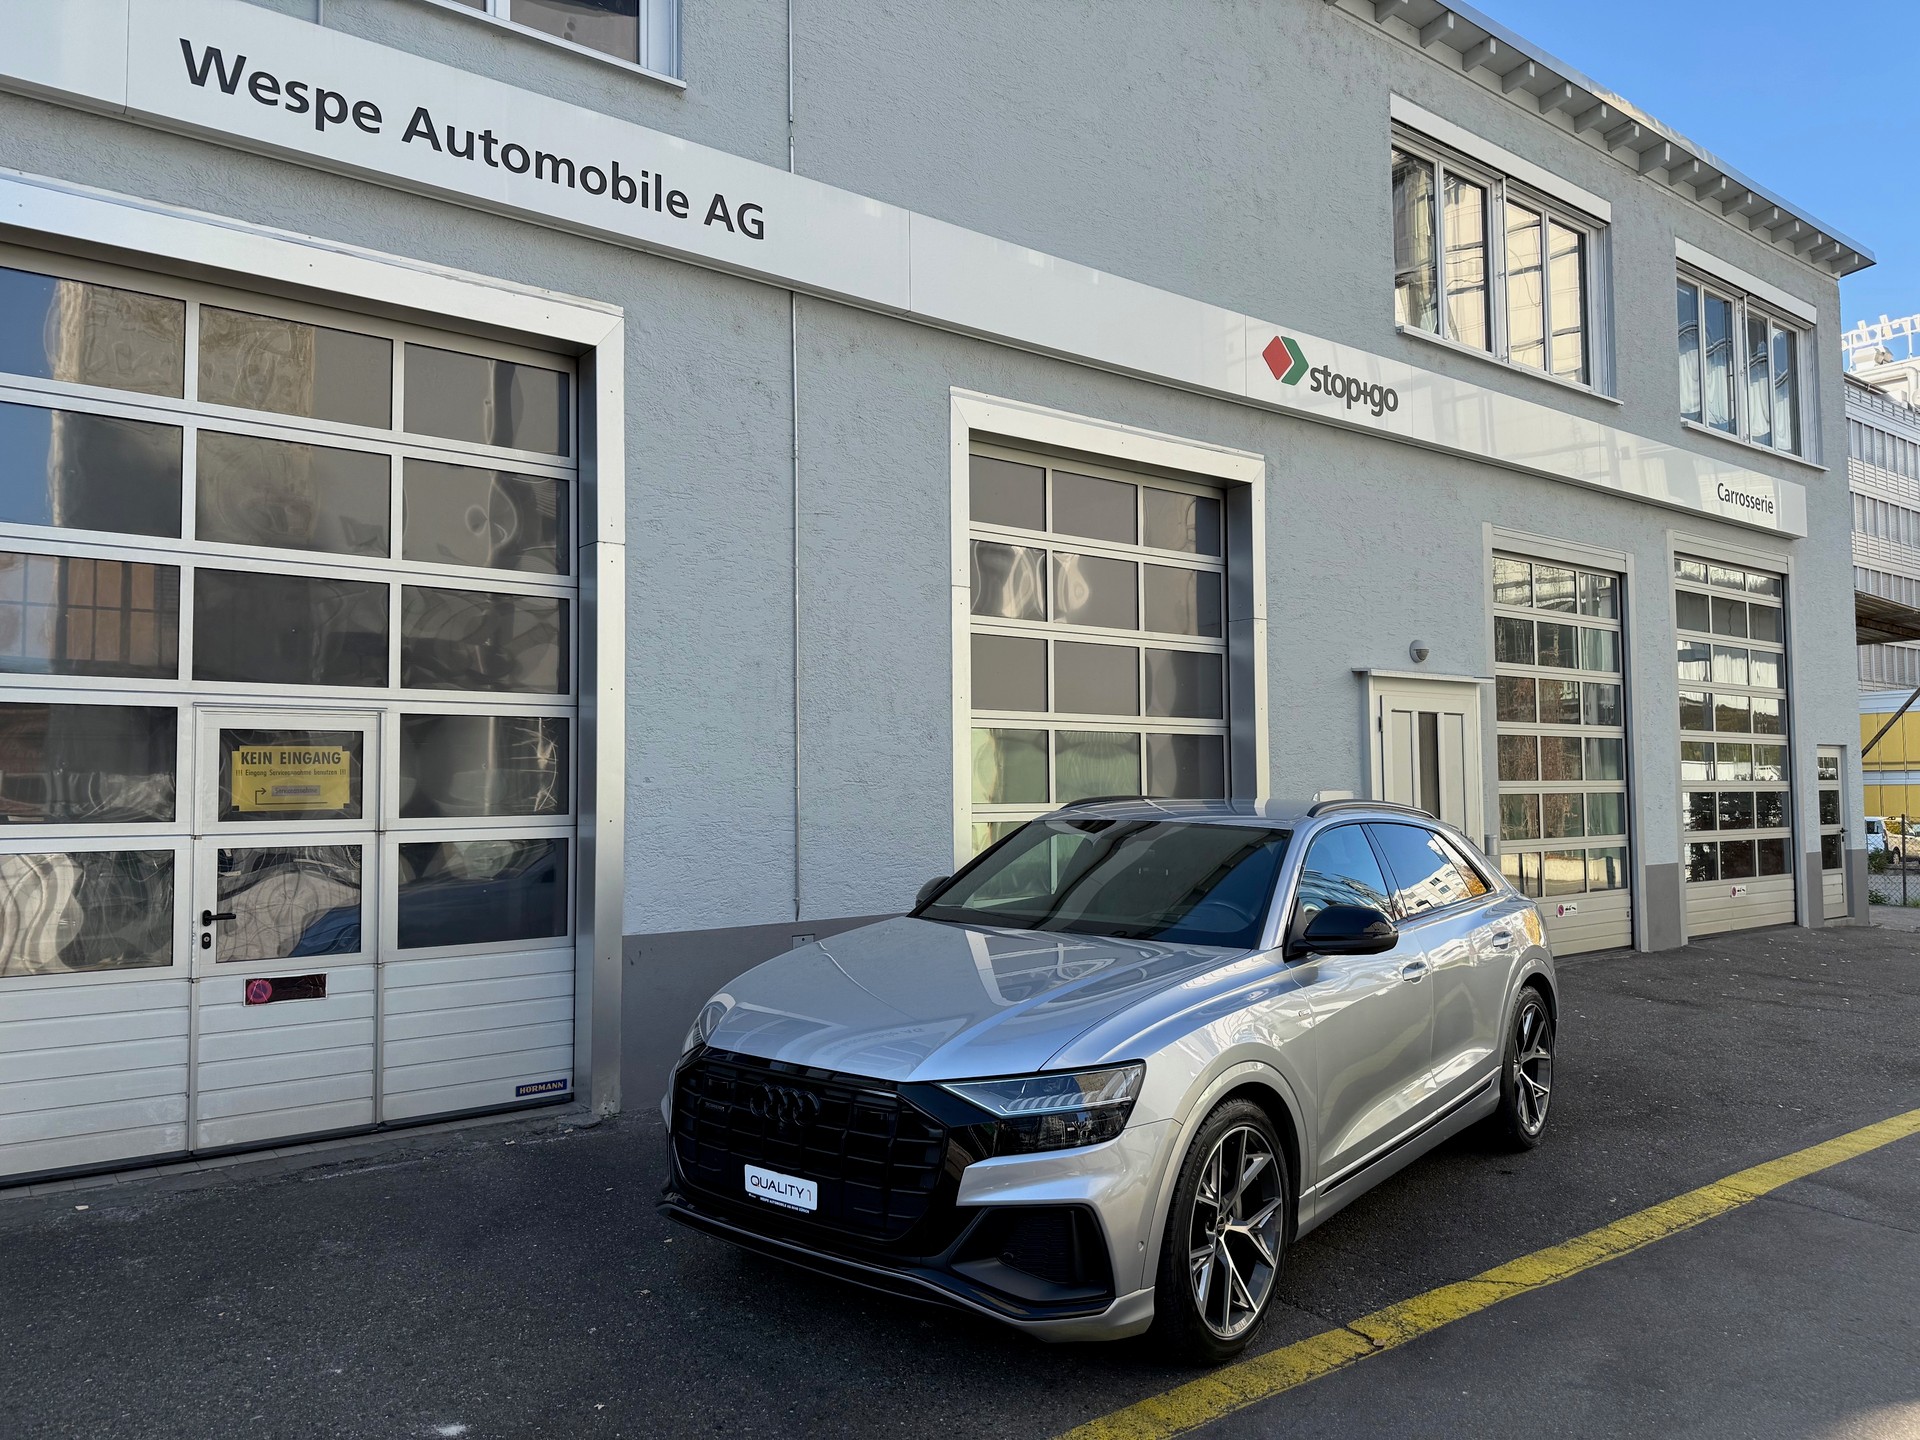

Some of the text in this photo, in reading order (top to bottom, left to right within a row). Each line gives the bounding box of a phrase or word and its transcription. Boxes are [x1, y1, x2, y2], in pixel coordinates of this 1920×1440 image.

[179, 37, 765, 240] Wespe Automobile AG
[1309, 364, 1399, 418] stop+go
[1717, 482, 1774, 515] Carrosserie
[241, 751, 342, 765] KEIN EINGANG
[245, 769, 268, 777] Eingang
[313, 768, 338, 776] benutzen
[750, 1174, 812, 1202] QUALITY 1
